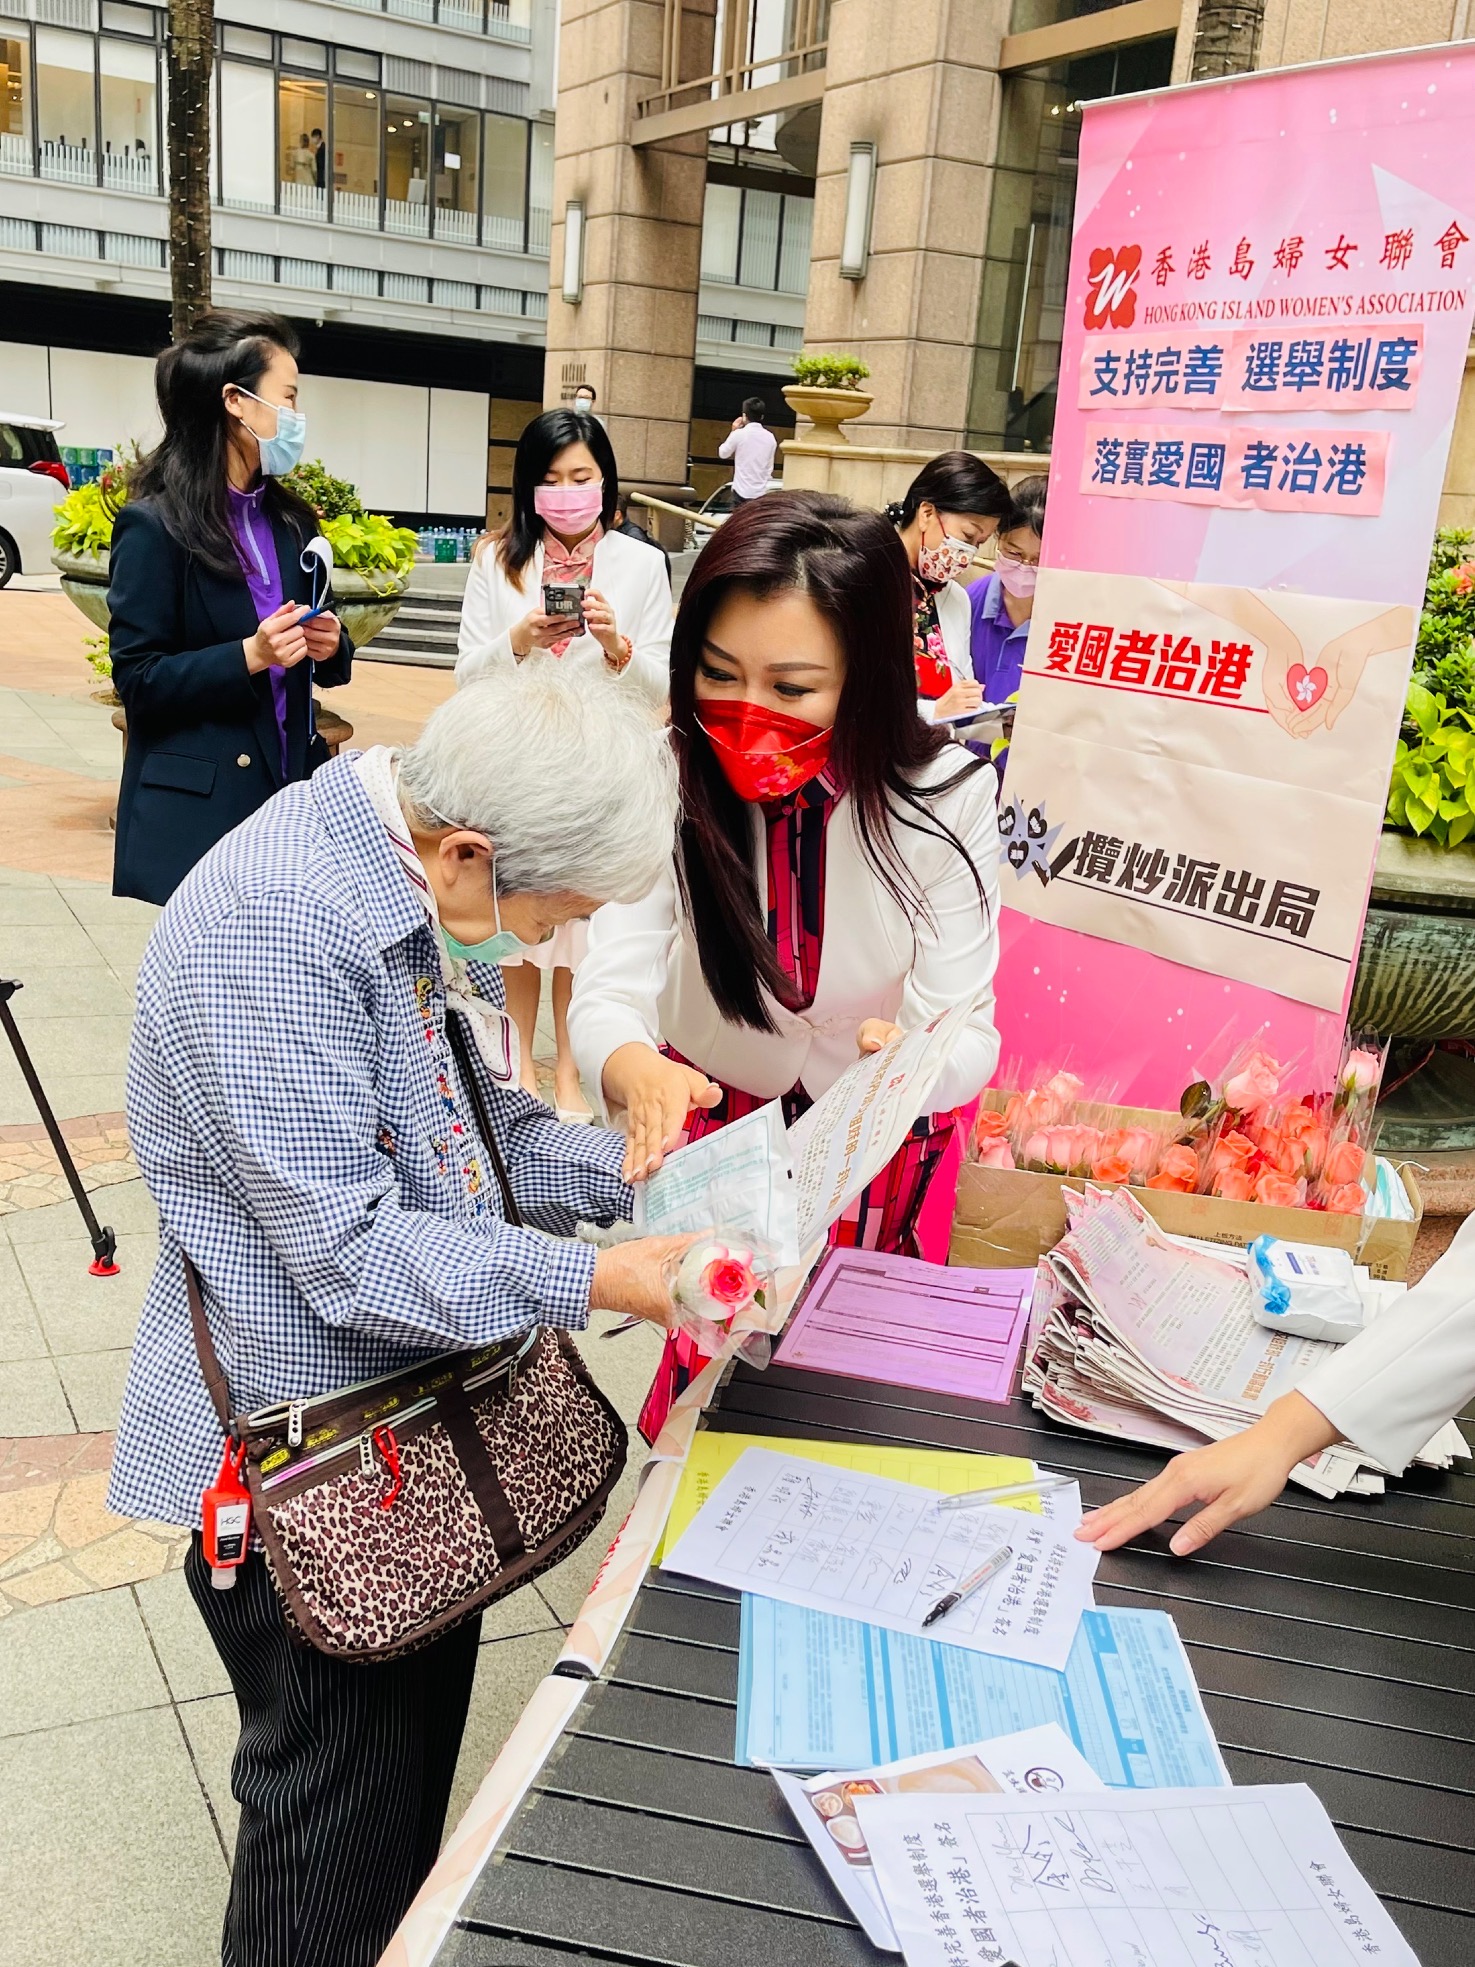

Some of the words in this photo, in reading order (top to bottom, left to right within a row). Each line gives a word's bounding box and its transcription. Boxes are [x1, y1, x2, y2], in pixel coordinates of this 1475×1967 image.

[1151, 220, 1470, 287] 香港島婦女聯會
[1144, 303, 1177, 325] HONG
[1179, 301, 1219, 322] KONG
[1221, 299, 1276, 321] ISLAND
[1279, 295, 1353, 318] WOMEN'S
[1355, 289, 1467, 315] ASSOCIATION
[1089, 344, 1224, 398] 支持完善
[1240, 336, 1418, 394] 選舉制度
[1091, 437, 1226, 492] 落實愛國
[1240, 440, 1367, 496] 者治港
[1045, 620, 1254, 700] 愛國者治港
[1072, 830, 1321, 939] 攬炒派出局
